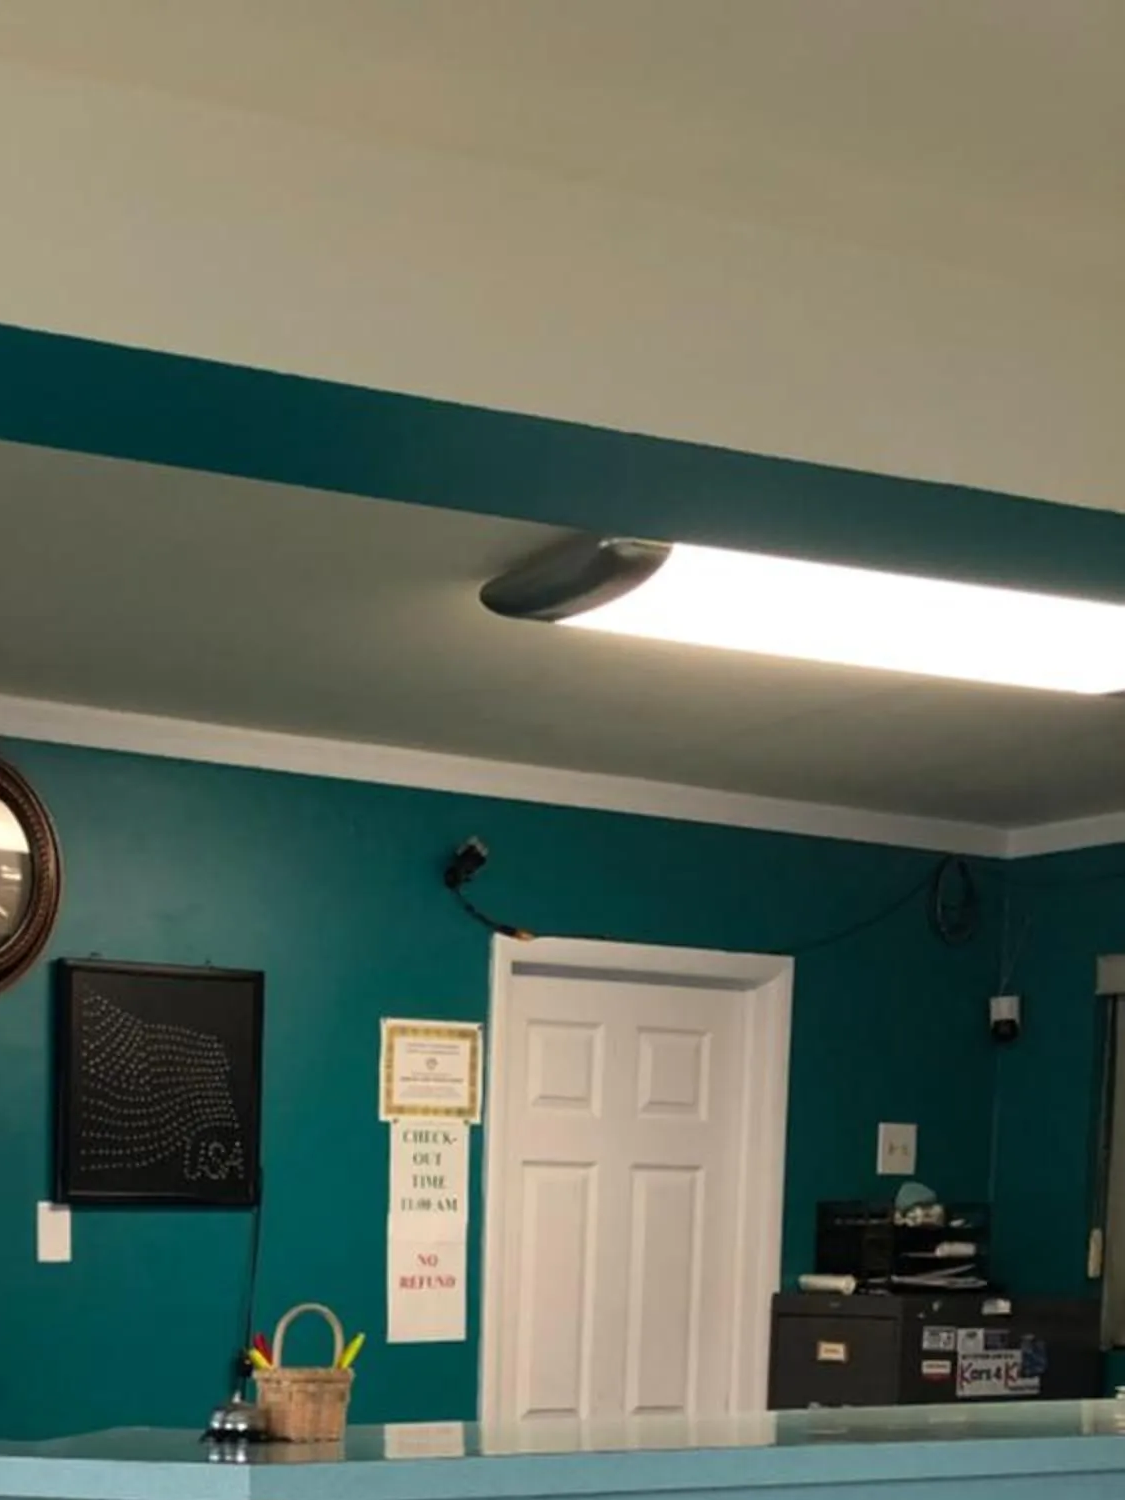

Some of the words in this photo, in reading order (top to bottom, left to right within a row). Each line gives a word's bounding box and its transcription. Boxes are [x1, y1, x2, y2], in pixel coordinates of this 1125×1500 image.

[403, 1130, 457, 1145] CHECK-
[183, 1140, 244, 1181] USA
[413, 1152, 441, 1166] OUT
[413, 1175, 446, 1189] TIME
[437, 1198, 458, 1212] AM
[418, 1253, 439, 1268] NO
[399, 1275, 456, 1290] REFUND
